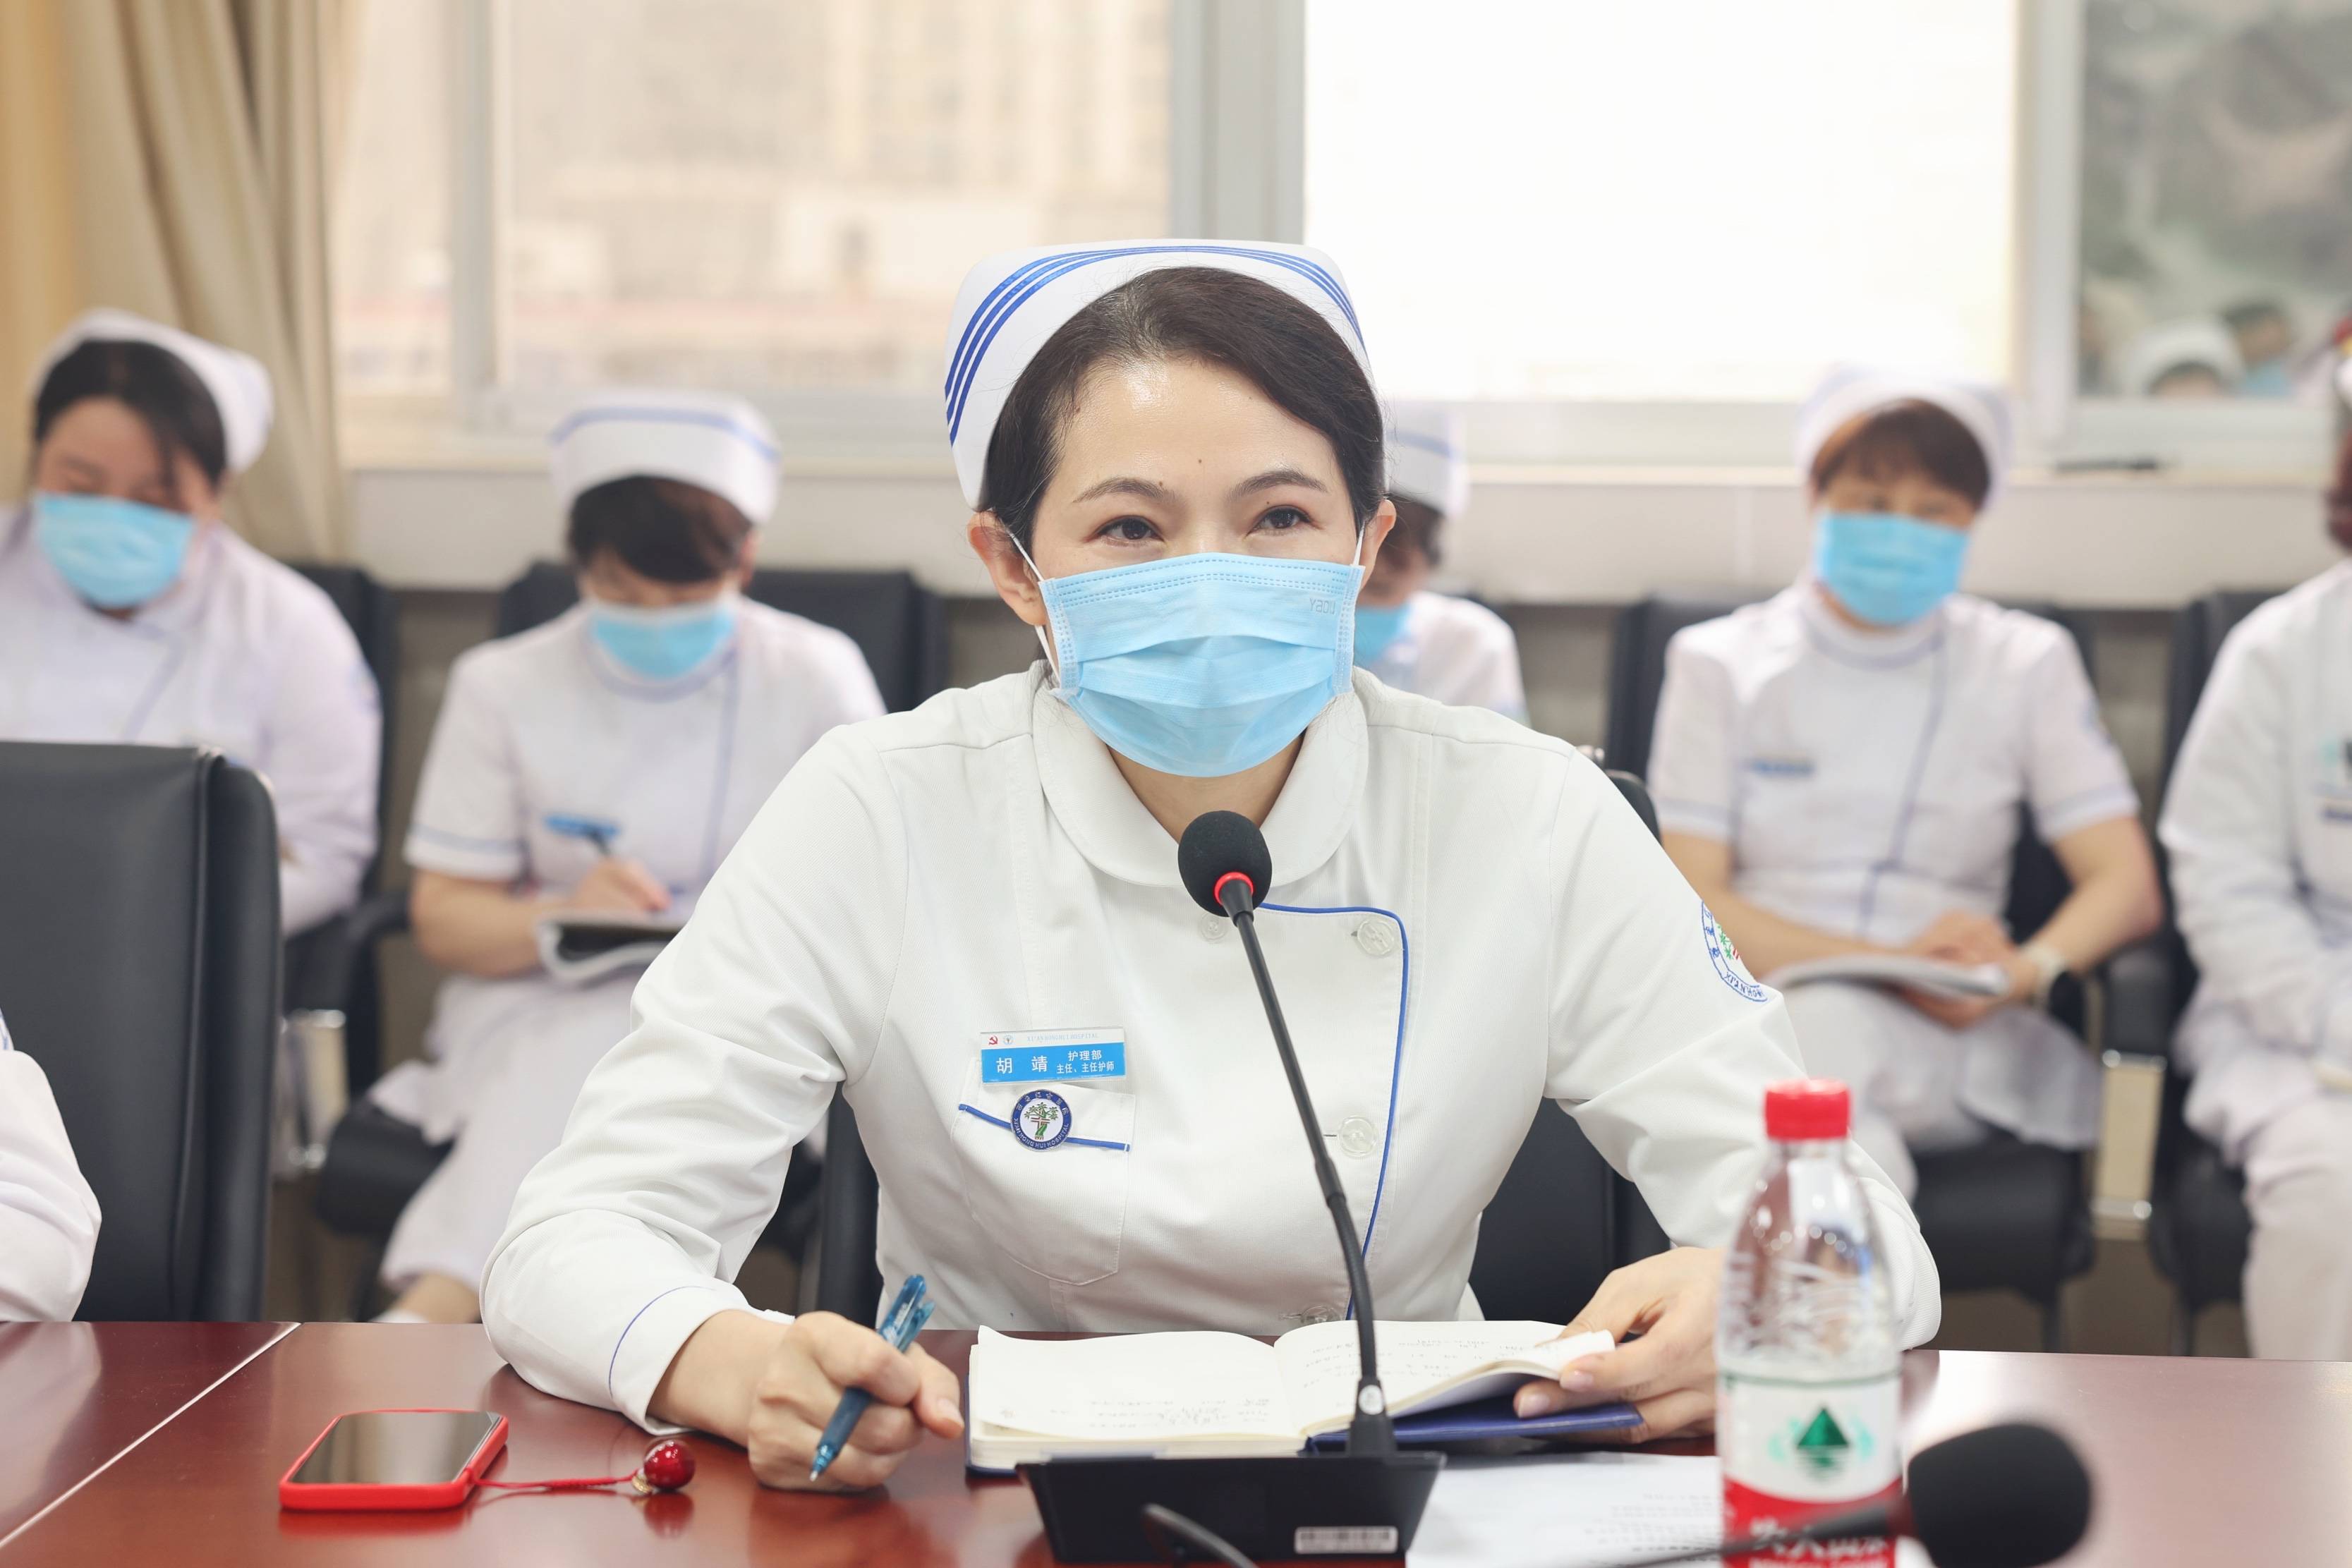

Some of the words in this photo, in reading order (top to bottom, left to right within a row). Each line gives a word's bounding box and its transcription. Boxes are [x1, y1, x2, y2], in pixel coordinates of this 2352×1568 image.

[1067, 1049, 1103, 1062] 护理部
[995, 1057, 1013, 1074] 胡
[1031, 1055, 1048, 1073] 靖
[1056, 1061, 1115, 1074] 主任、主任护师
